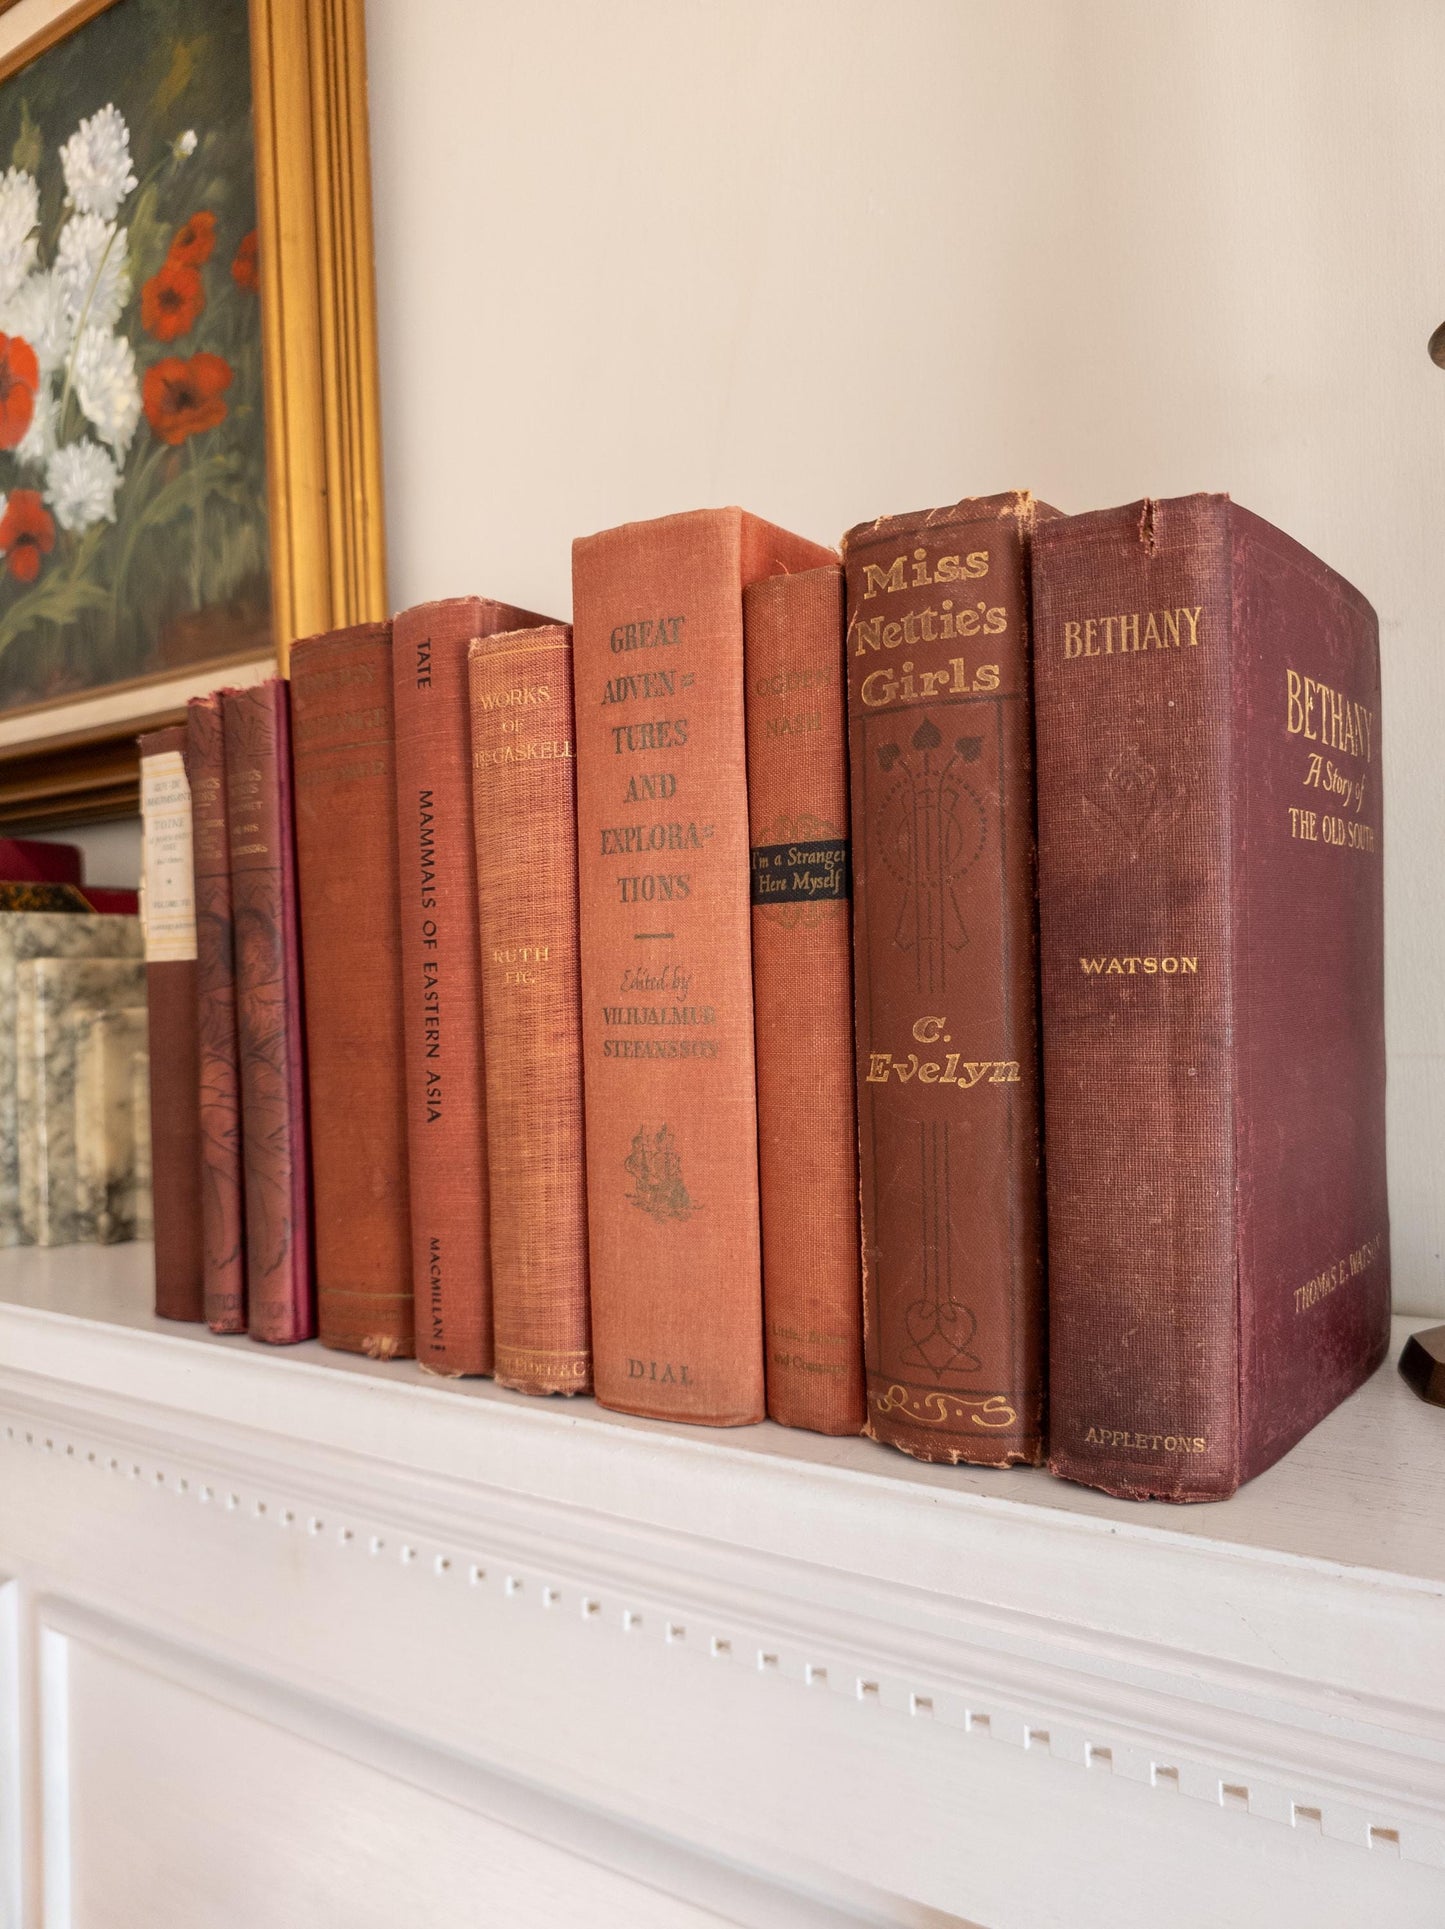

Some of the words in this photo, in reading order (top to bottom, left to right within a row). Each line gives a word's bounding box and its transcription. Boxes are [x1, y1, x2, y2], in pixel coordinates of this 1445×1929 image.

[863, 548, 989, 599] Miss
[610, 616, 685, 653] GREAT
[855, 599, 1008, 656] Nettie's
[1063, 606, 1202, 659] BETHANY
[416, 637, 432, 690] TATE
[861, 657, 1000, 706] Girls
[480, 685, 551, 710] WORKS
[502, 717, 524, 732] OF
[765, 710, 823, 738] NASH
[1286, 669, 1373, 763] BETHANY
[612, 719, 688, 754] TURES
[624, 773, 677, 803] AND
[1303, 753, 1323, 788] A
[1323, 761, 1353, 807] Story
[1355, 773, 1367, 813] of
[1288, 807, 1318, 841] THE
[1322, 815, 1346, 846] OLD
[1347, 820, 1375, 852] SOUTH
[418, 790, 437, 909] MAMMALS
[774, 854, 782, 866] a
[617, 873, 691, 903] TIONS
[759, 873, 787, 893] Here
[792, 869, 843, 895] Myself
[422, 919, 438, 950] OF
[493, 946, 550, 963] RUTH
[1079, 957, 1199, 975] WATSON
[620, 966, 668, 992] Edited
[672, 966, 692, 1002] by
[423, 961, 441, 1059] EASTERN
[866, 1053, 1021, 1089] Evelyn
[425, 1070, 442, 1124] ASIA
[430, 1237, 443, 1339] MACMILLAN
[628, 1359, 694, 1386] DIAL
[1084, 1426, 1207, 1453] APPLETONS
